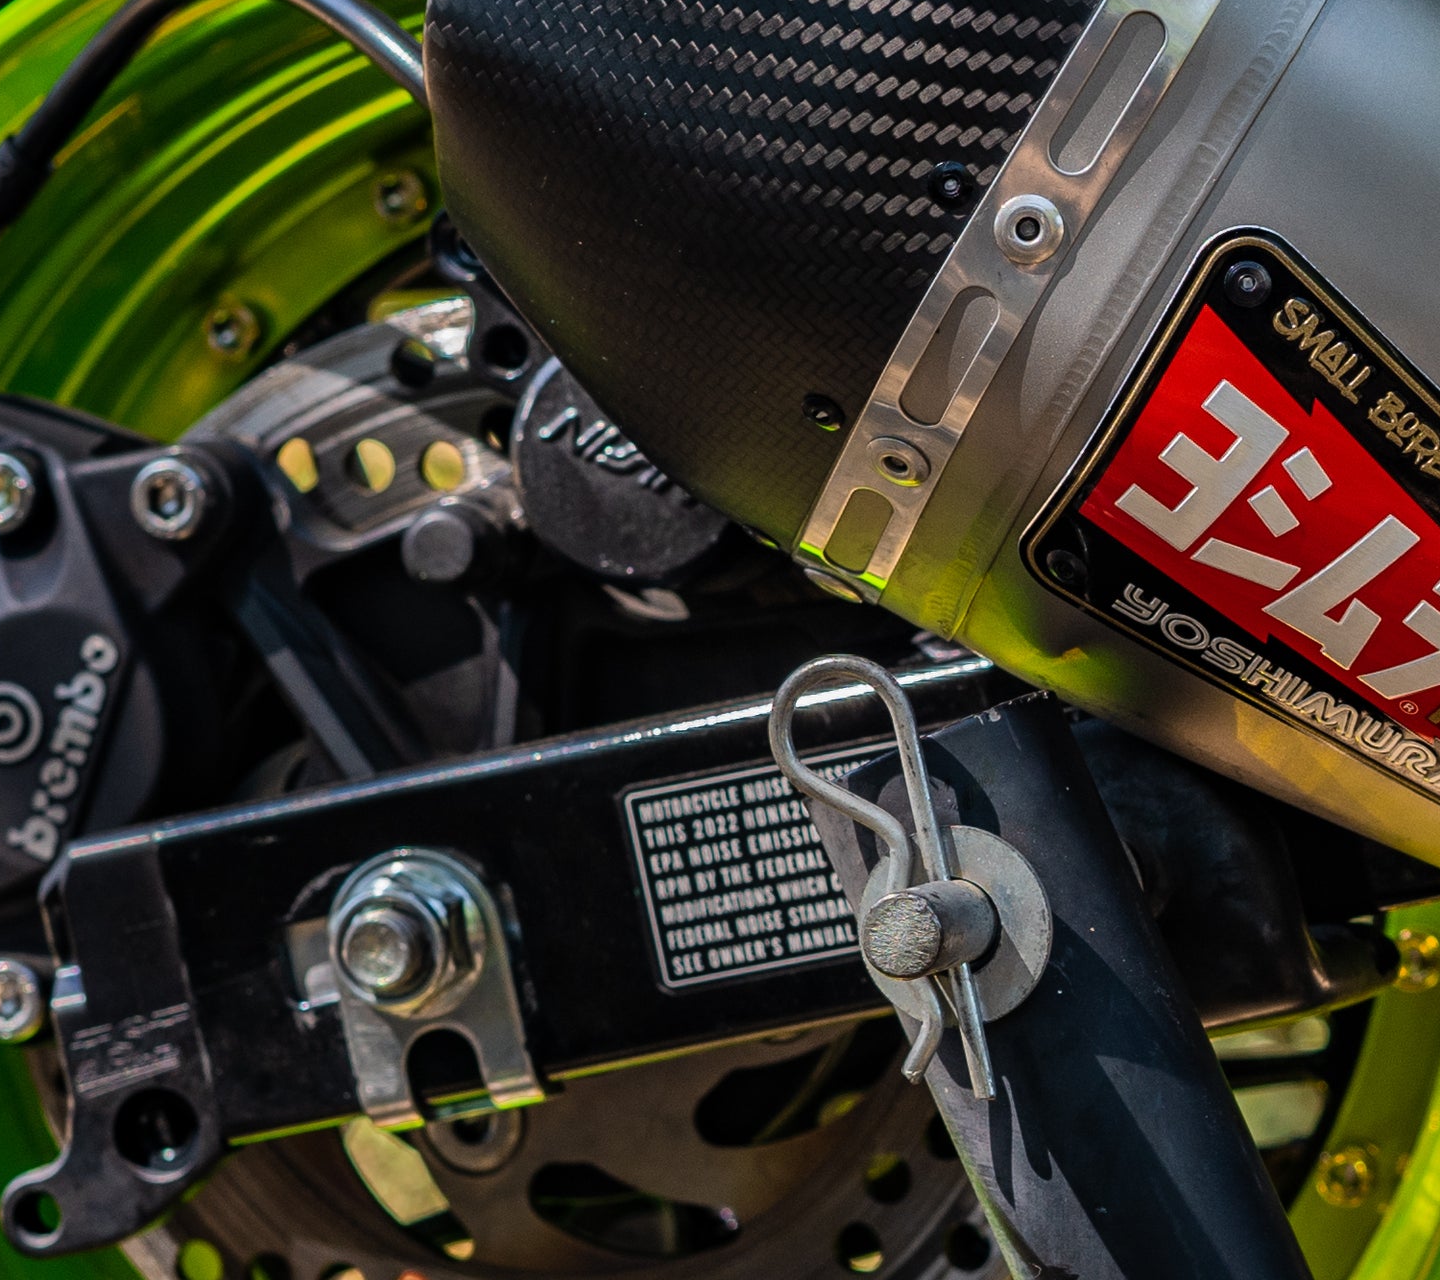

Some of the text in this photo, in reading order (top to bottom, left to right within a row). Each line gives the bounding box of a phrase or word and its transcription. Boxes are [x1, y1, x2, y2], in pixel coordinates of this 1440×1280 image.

[7, 633, 119, 861] brembo
[638, 786, 740, 824] MOTORCYCLE
[742, 776, 792, 803] NOISE
[643, 823, 687, 849] THIS
[692, 813, 740, 840] 2022
[649, 850, 685, 875] EPA
[688, 838, 743, 866] NOISE
[655, 849, 828, 900] RPM BY THE FEDERAL
[660, 885, 776, 926] MODIFICATIONS
[776, 876, 828, 902] WHICH
[667, 919, 734, 951] FEDERAL
[735, 909, 785, 937] NOISE
[672, 951, 705, 976] SEE
[708, 937, 784, 969] OWNER'S
